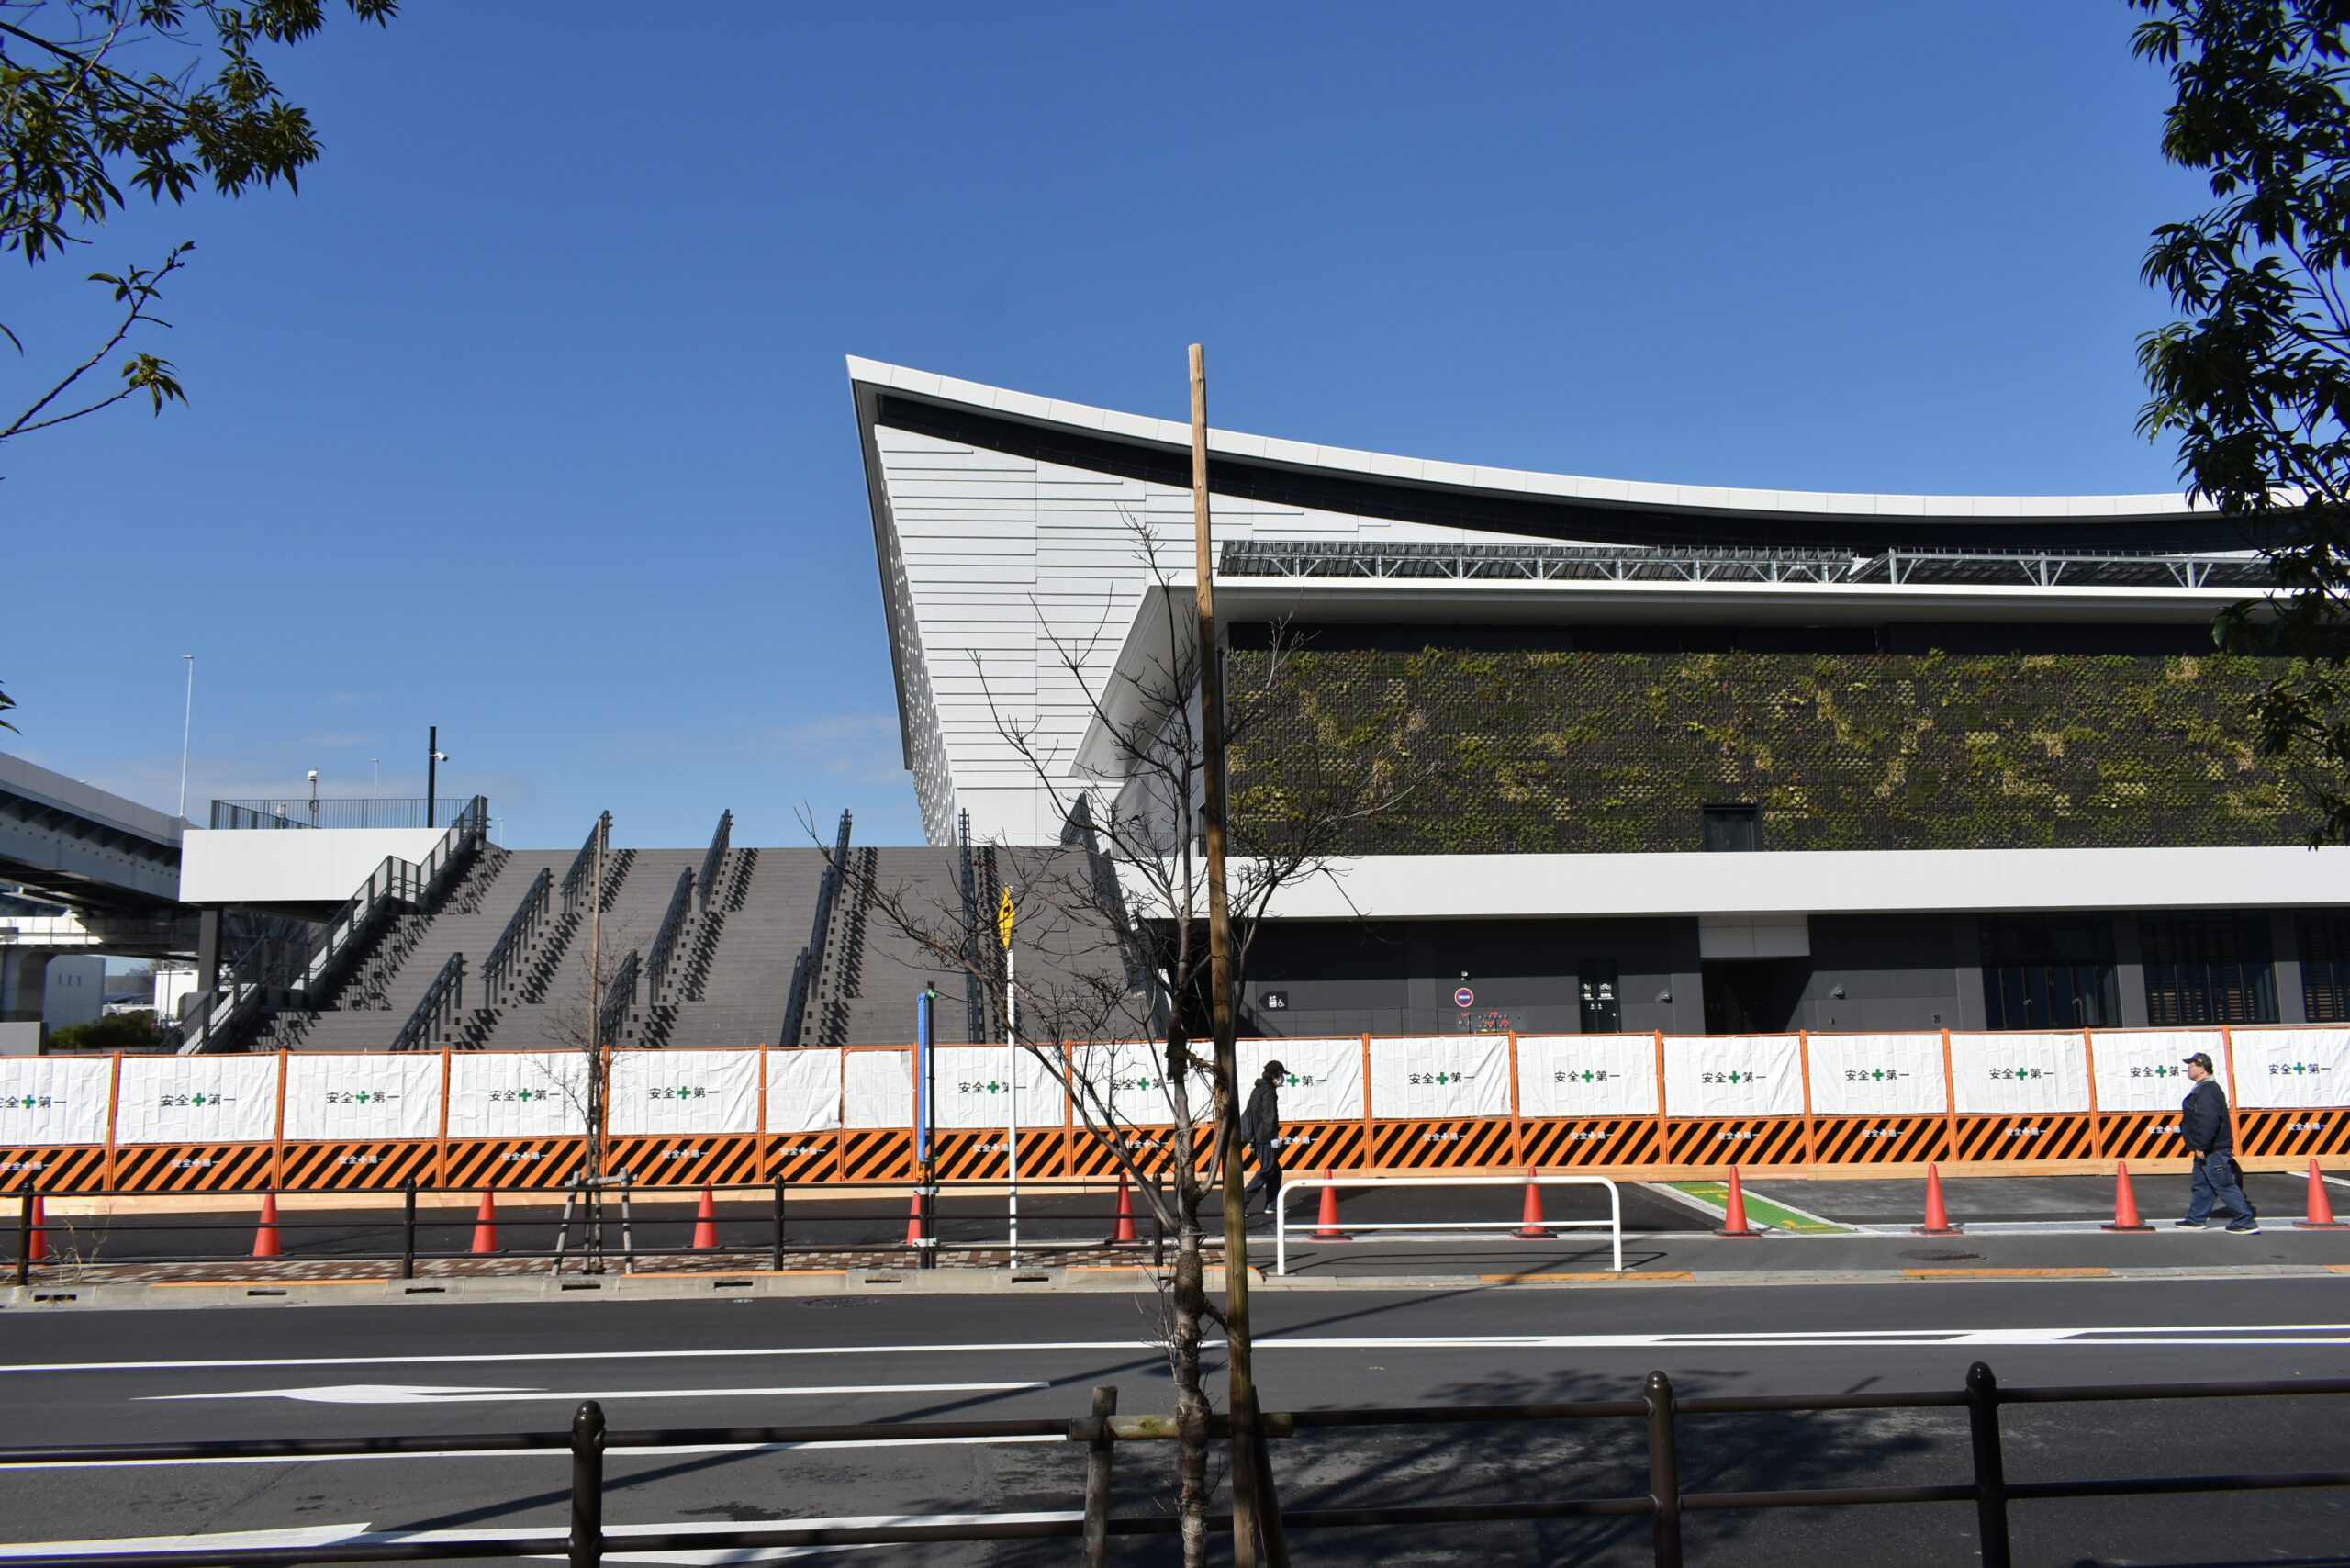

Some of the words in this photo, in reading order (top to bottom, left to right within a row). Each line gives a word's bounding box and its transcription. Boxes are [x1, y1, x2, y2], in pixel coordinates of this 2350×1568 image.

[1845, 1070, 1870, 1081] 安全
[1886, 1069, 1910, 1081] 第一
[1989, 1068, 2014, 1080] 安全
[2030, 1068, 2054, 1080] 第一
[2130, 1066, 2154, 1078] 安全
[2268, 1063, 2292, 1075] 安全
[2307, 1062, 2332, 1074] 第一
[1301, 1074, 1327, 1087] 第一
[1408, 1073, 1434, 1085] 安全
[1450, 1072, 1475, 1084] 第一
[1554, 1071, 1580, 1083] 安全
[1595, 1070, 1620, 1082] 第一
[1701, 1071, 1727, 1083] 安全
[1742, 1071, 1767, 1083] 第一
[648, 1087, 676, 1099] 安全
[692, 1086, 721, 1099] 第一
[958, 1081, 985, 1093] 安全
[37, 1095, 67, 1108] 第一
[160, 1094, 190, 1107] 安全
[207, 1093, 237, 1106] 第一
[325, 1091, 353, 1103] 安全
[371, 1091, 400, 1103] 第一
[488, 1089, 517, 1102] 安全
[533, 1088, 562, 1101] 第一
